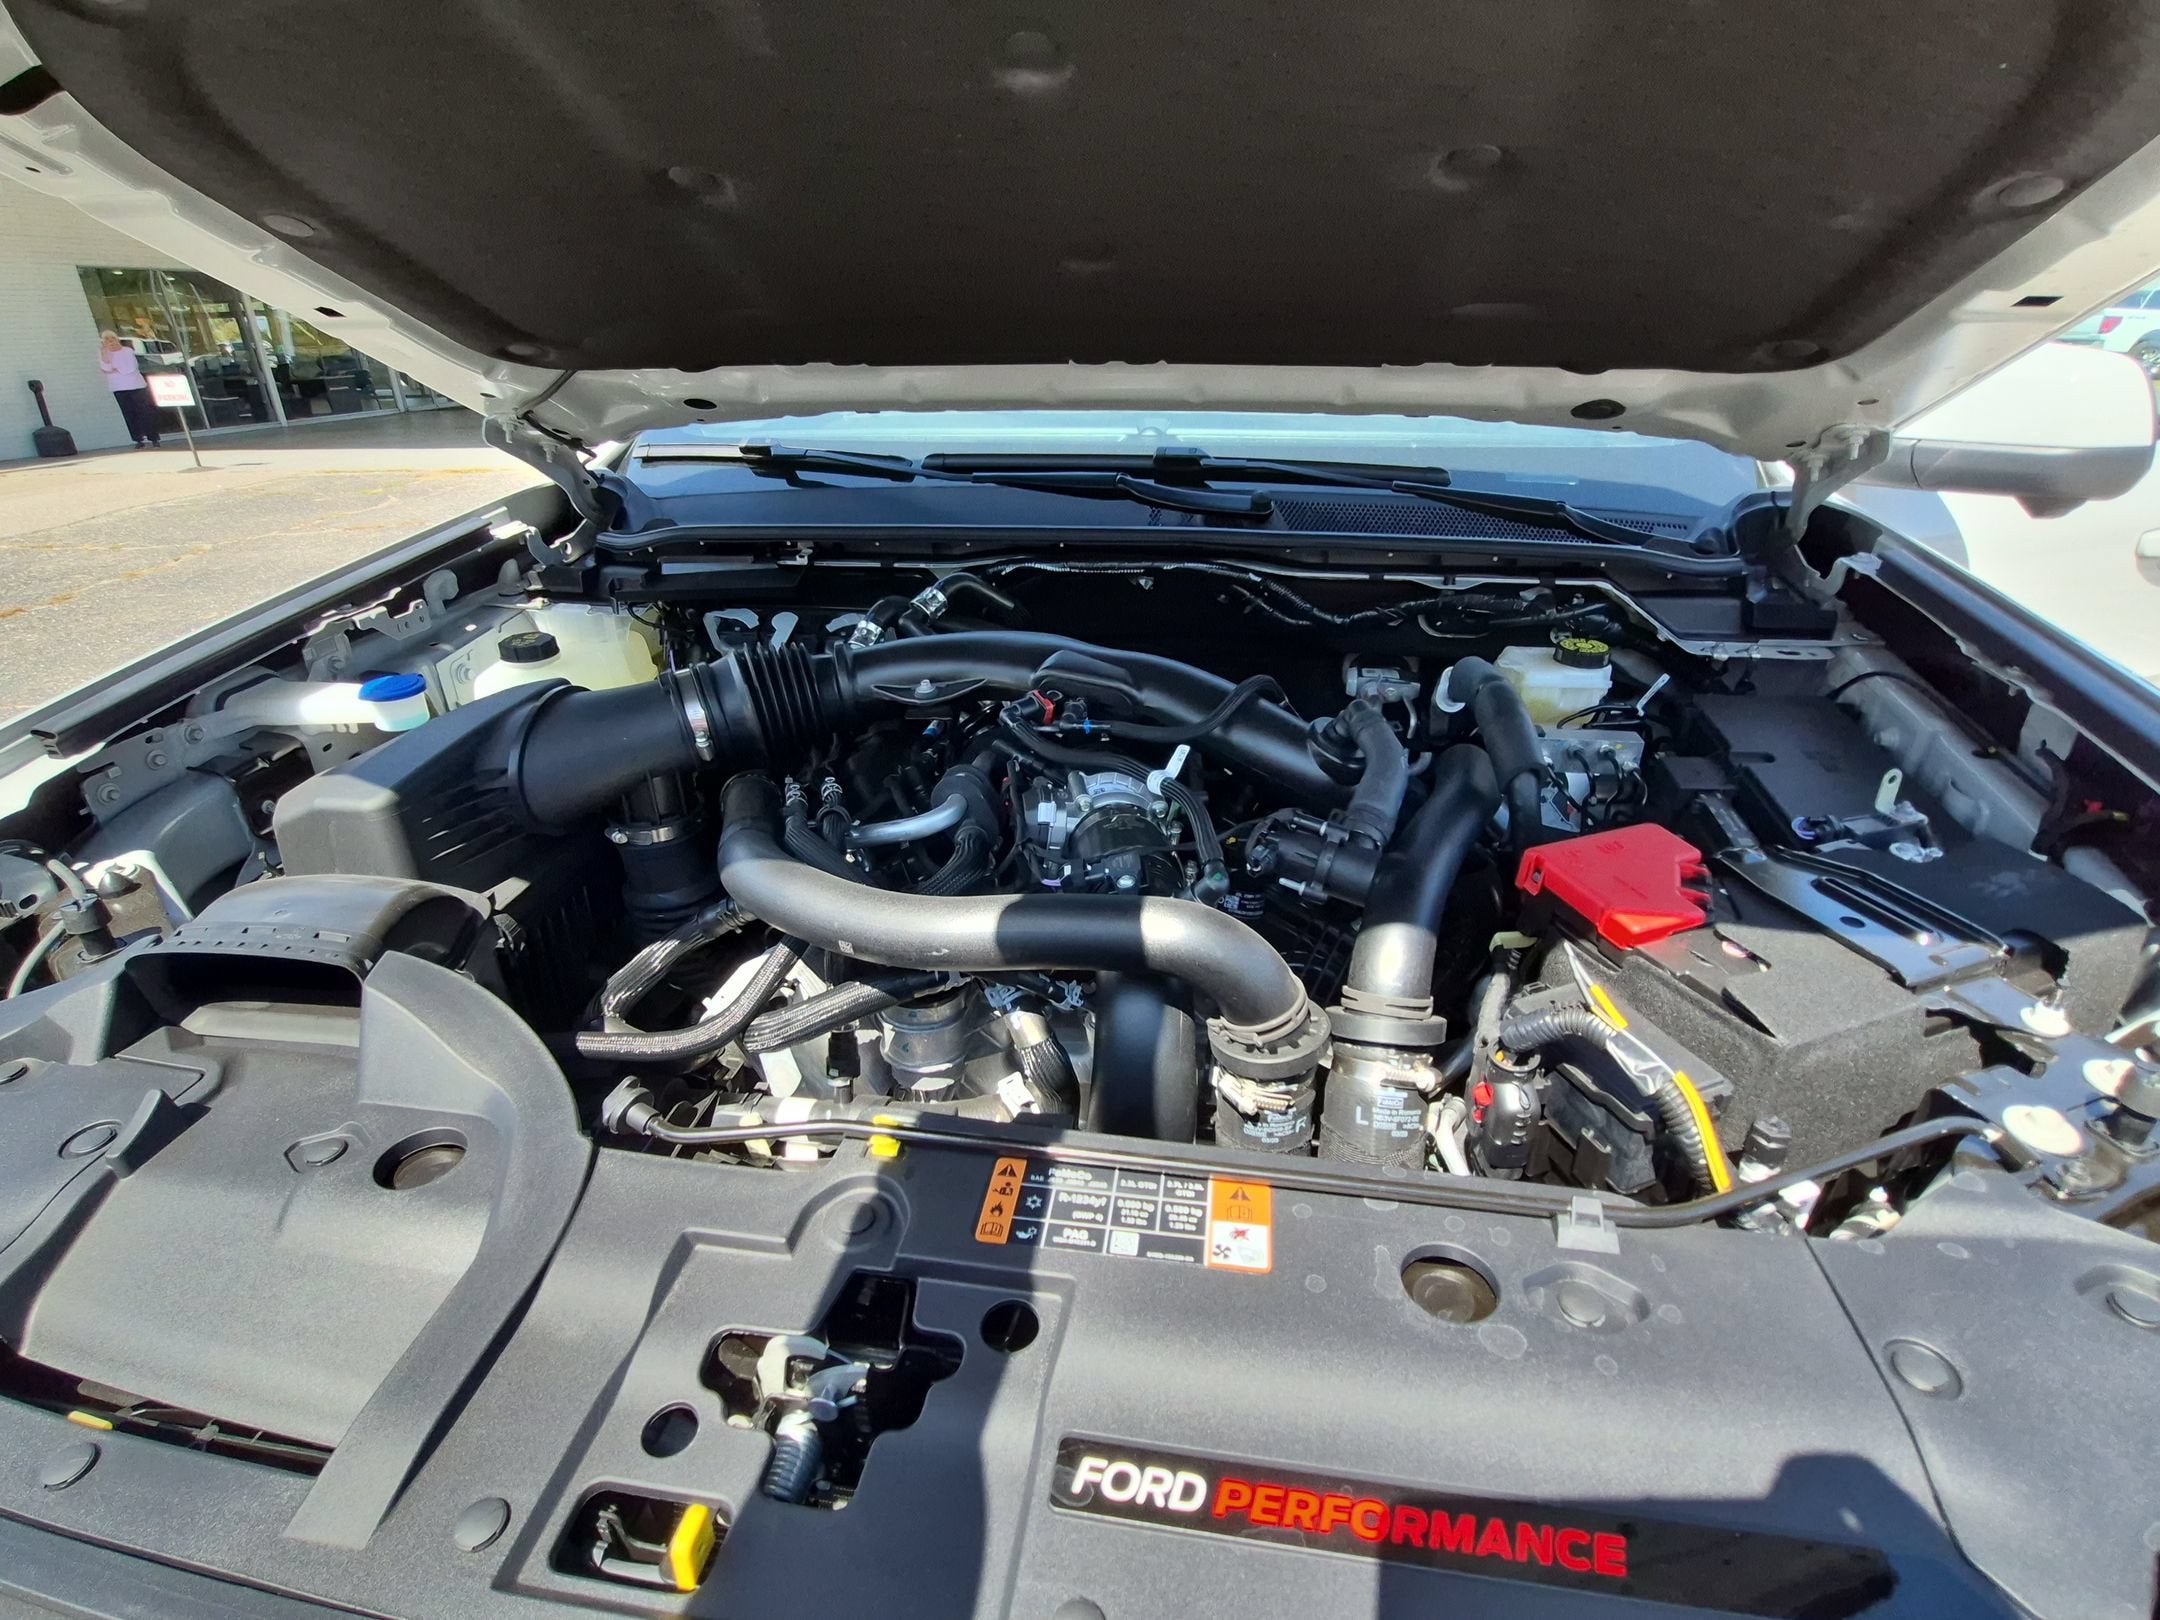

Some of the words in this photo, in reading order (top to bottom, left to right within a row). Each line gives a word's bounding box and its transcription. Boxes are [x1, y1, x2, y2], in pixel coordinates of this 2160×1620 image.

[1355, 1105, 1369, 1125] L
[1070, 1455, 1208, 1513] FORD
[1212, 1476, 1629, 1577] PERFORMANCE
